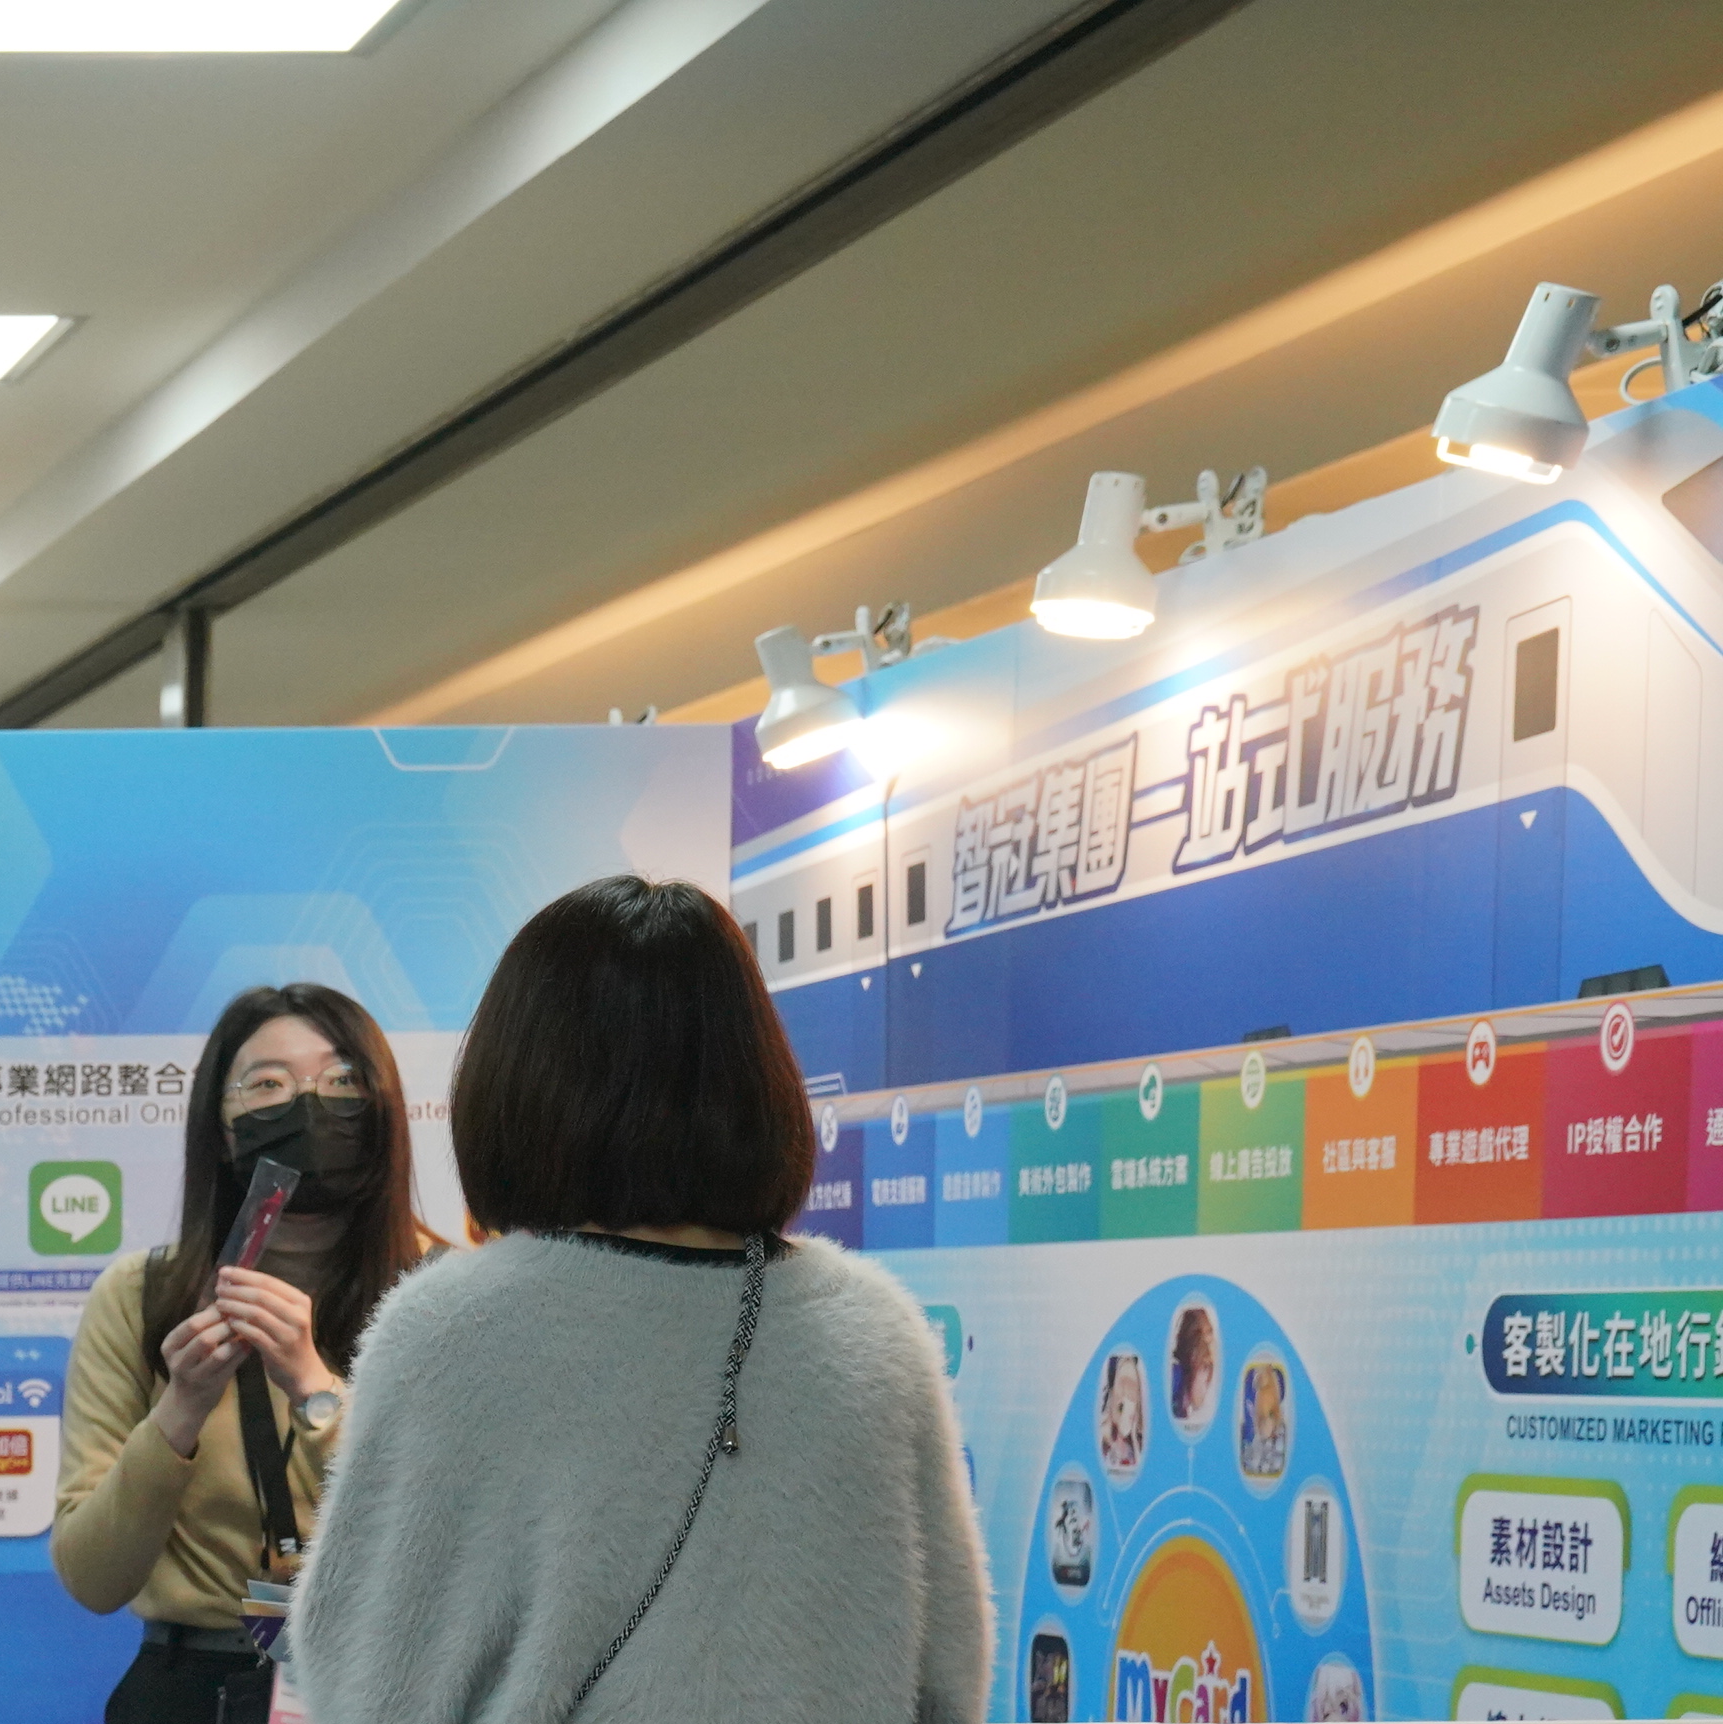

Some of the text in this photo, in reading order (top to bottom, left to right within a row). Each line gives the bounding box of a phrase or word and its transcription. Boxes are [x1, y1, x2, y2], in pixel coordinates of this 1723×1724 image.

[945, 603, 1482, 940] 智冠集團一站式服務
[1567, 1113, 1664, 1155] IP授權合作
[51, 1195, 100, 1214] LINE
[1506, 1414, 1714, 1446] CUSTOMIZED MARKETING
[1489, 1516, 1593, 1574] 素材設計
[1482, 1577, 1597, 1621] Assets Design
